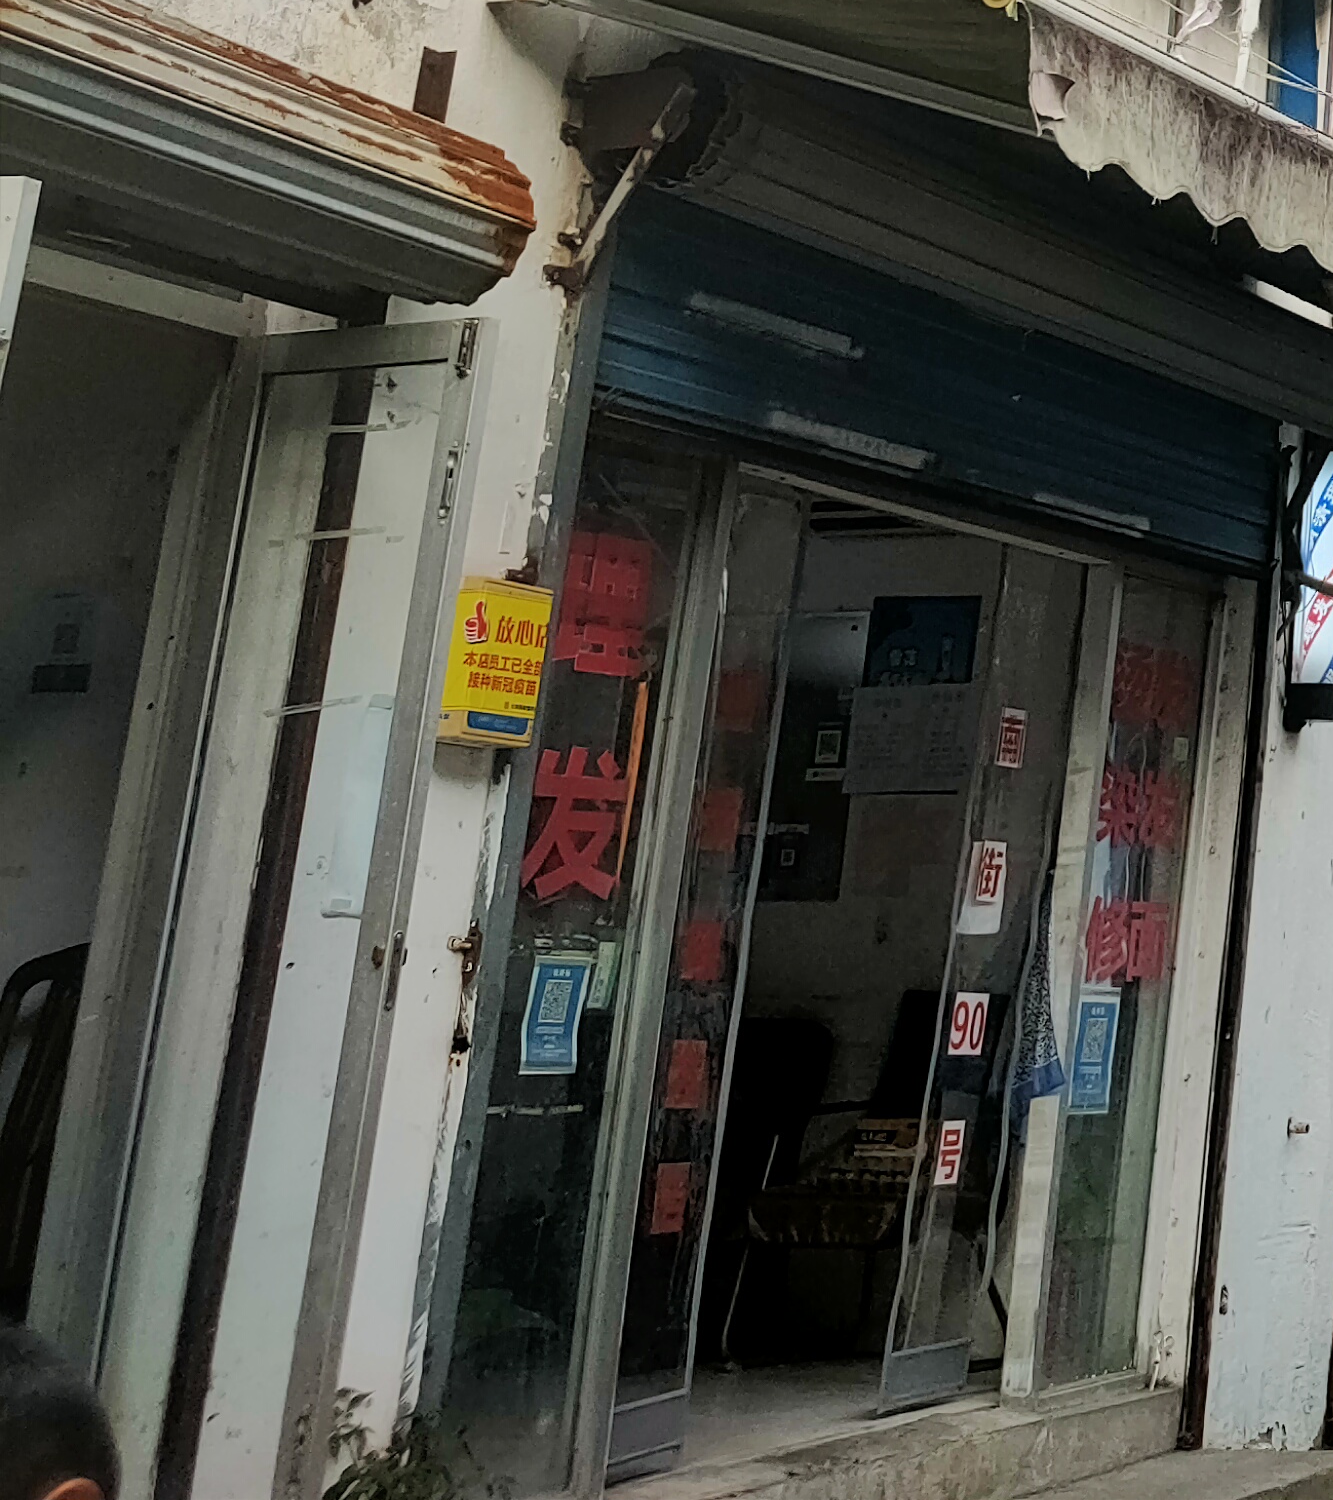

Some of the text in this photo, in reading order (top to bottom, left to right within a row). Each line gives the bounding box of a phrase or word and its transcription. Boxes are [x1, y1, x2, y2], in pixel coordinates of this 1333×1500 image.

[468, 671, 537, 697] 接种新冠疫苗
[950, 1001, 985, 1050] 90
